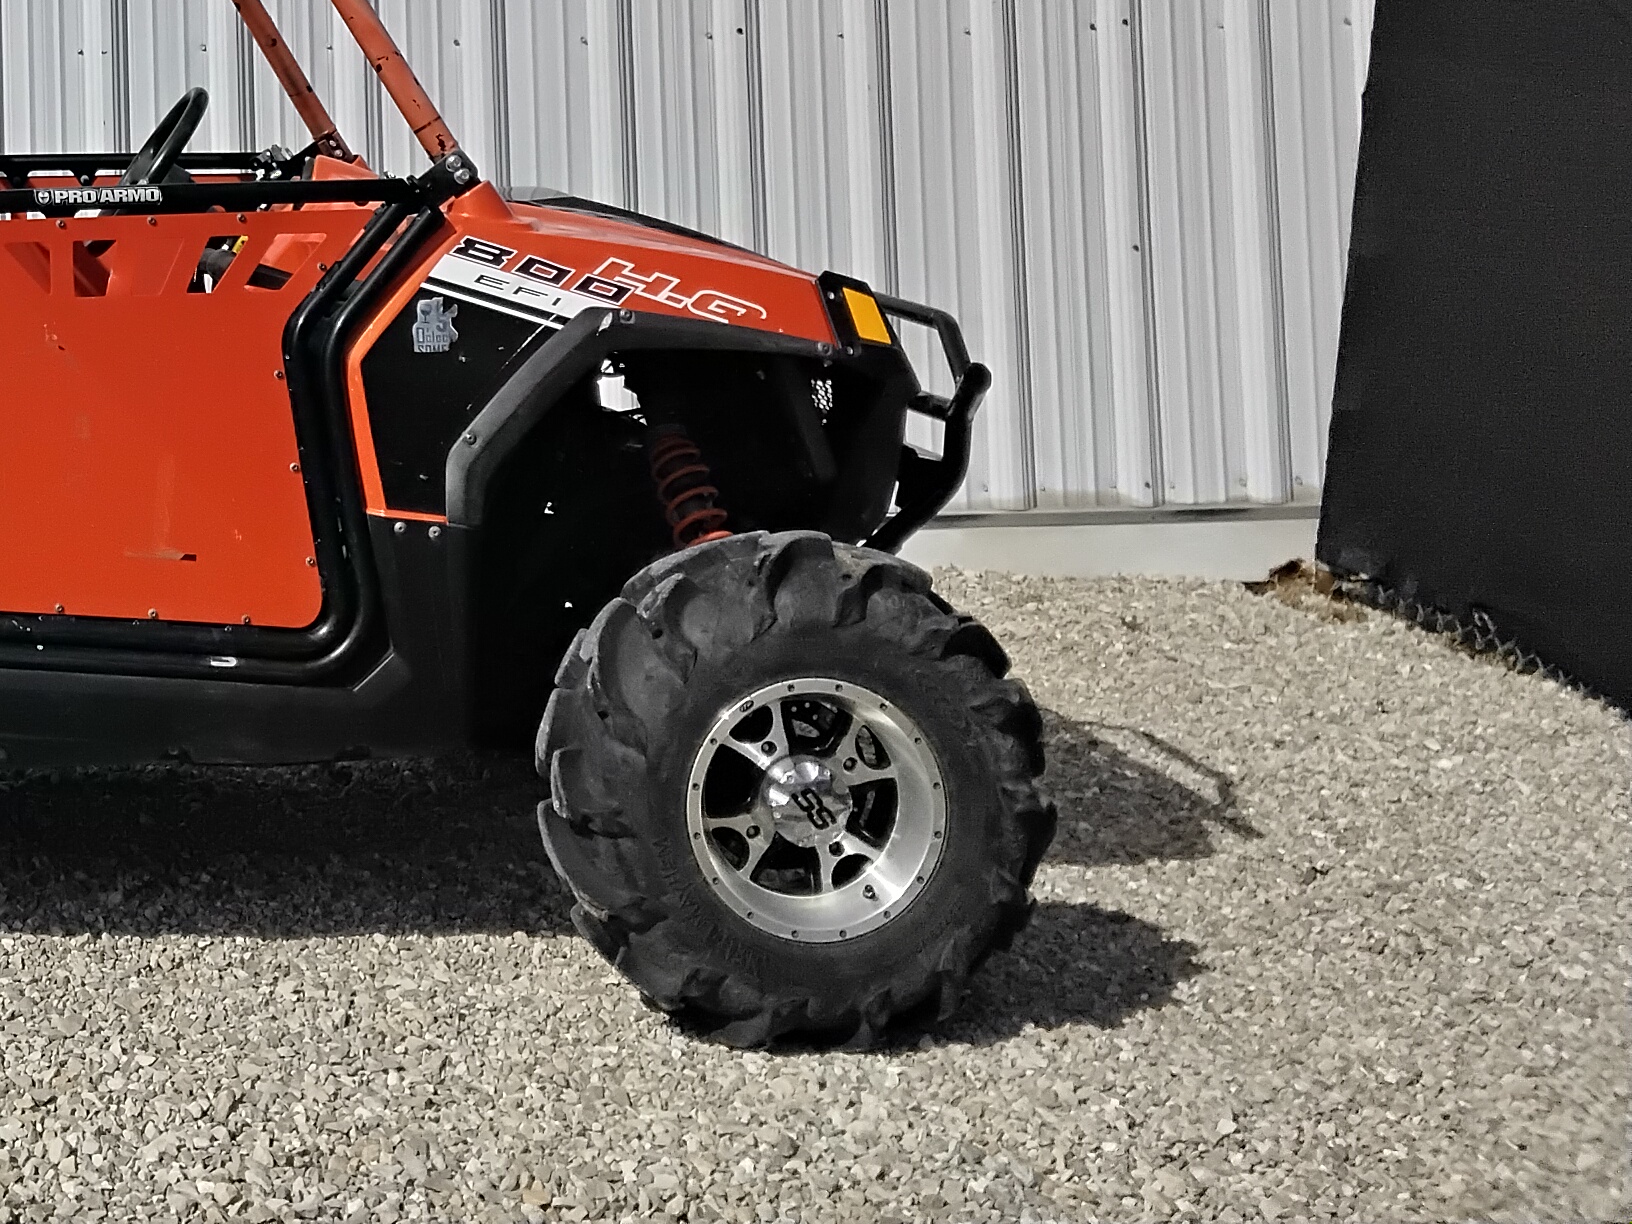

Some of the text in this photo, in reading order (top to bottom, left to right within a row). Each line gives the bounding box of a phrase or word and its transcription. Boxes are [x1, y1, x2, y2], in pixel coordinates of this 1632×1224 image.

[53, 187, 161, 204] PRO ARMO
[450, 235, 635, 306] 800
[474, 274, 562, 306] EFI
